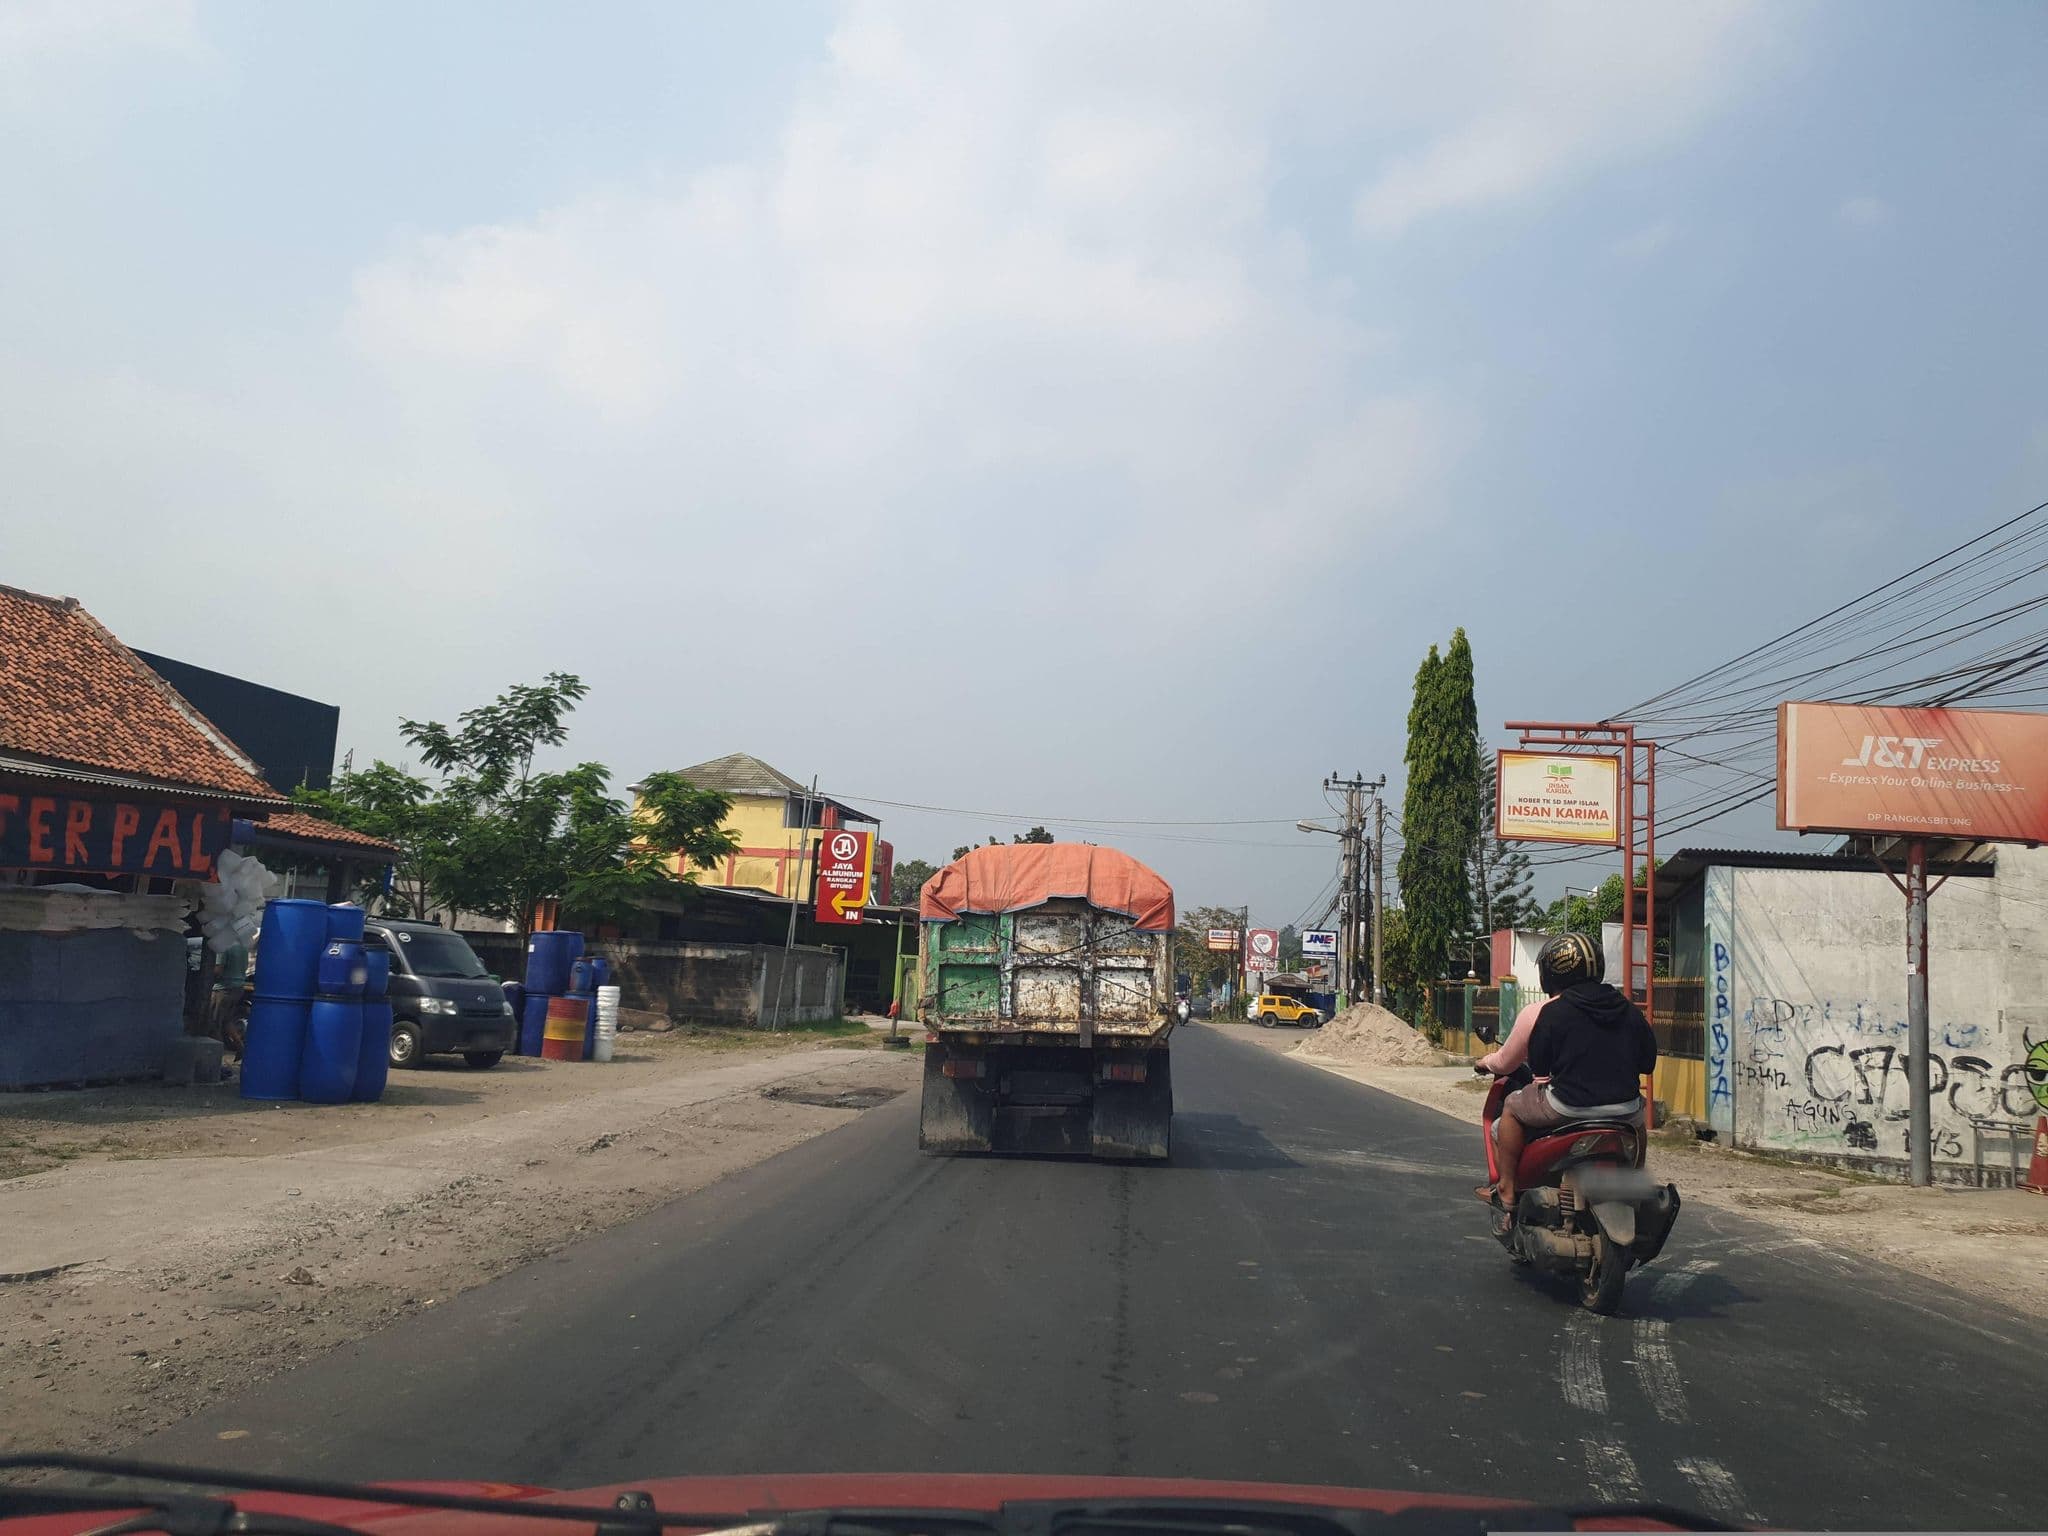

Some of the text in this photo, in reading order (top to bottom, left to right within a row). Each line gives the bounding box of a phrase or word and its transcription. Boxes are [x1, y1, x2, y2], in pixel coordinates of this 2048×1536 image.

[1842, 736, 2001, 774] J&T EXPRESS
[1829, 772, 2012, 792] Express Your Online Business
[1508, 805, 1610, 820] INSAN KARIMA
[1867, 813, 1973, 826] DP RANGKASBITUNG
[845, 911, 859, 920] IN
[1306, 934, 1334, 944] JNE
